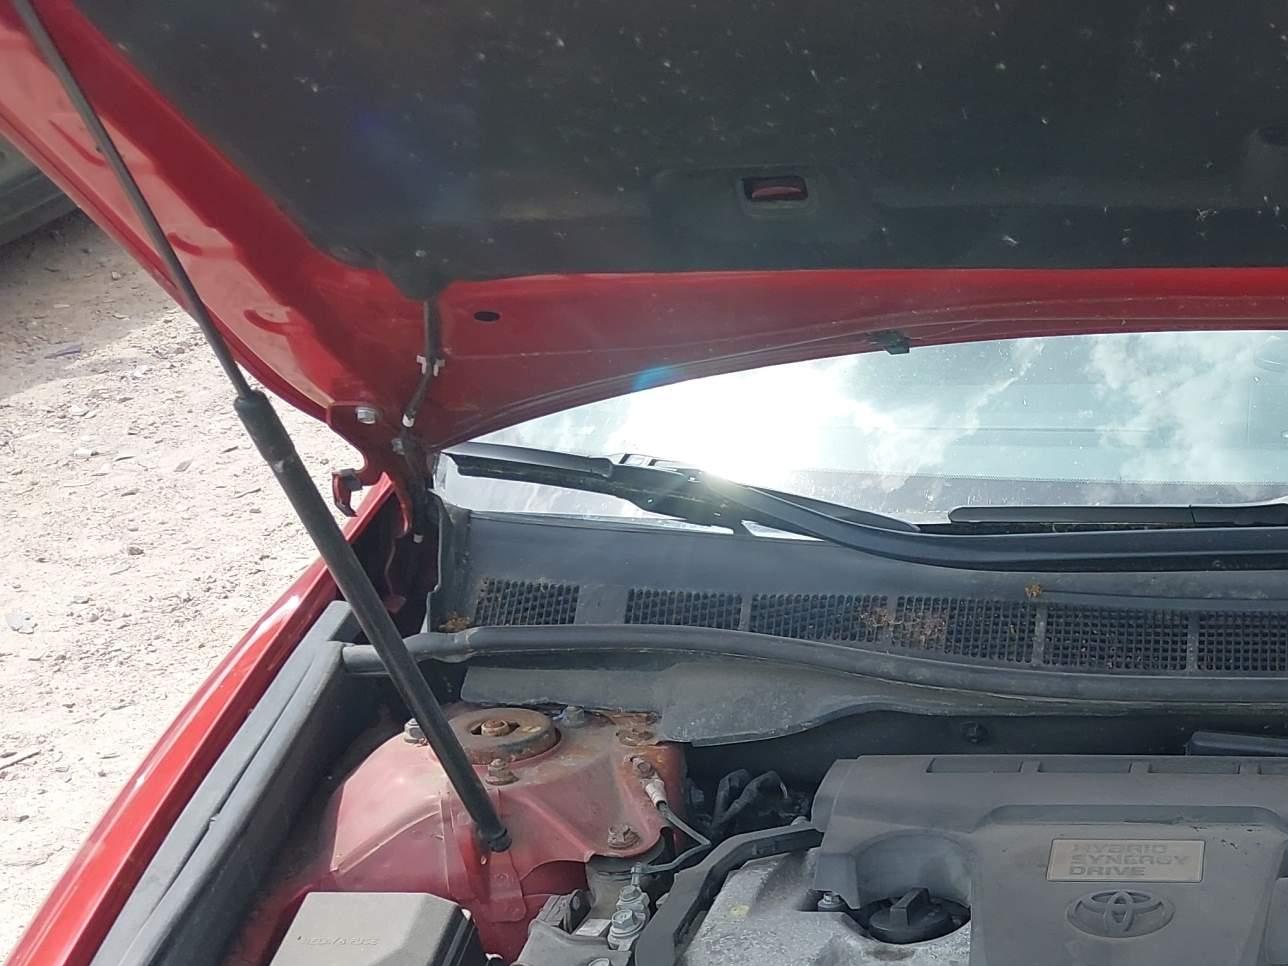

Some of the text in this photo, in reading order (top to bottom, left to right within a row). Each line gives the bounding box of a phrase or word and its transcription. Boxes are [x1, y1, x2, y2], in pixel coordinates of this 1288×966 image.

[1072, 843, 1168, 854] HYBRID
[1070, 854, 1192, 865] SYNERGY
[1069, 865, 1146, 876] DRIVE
